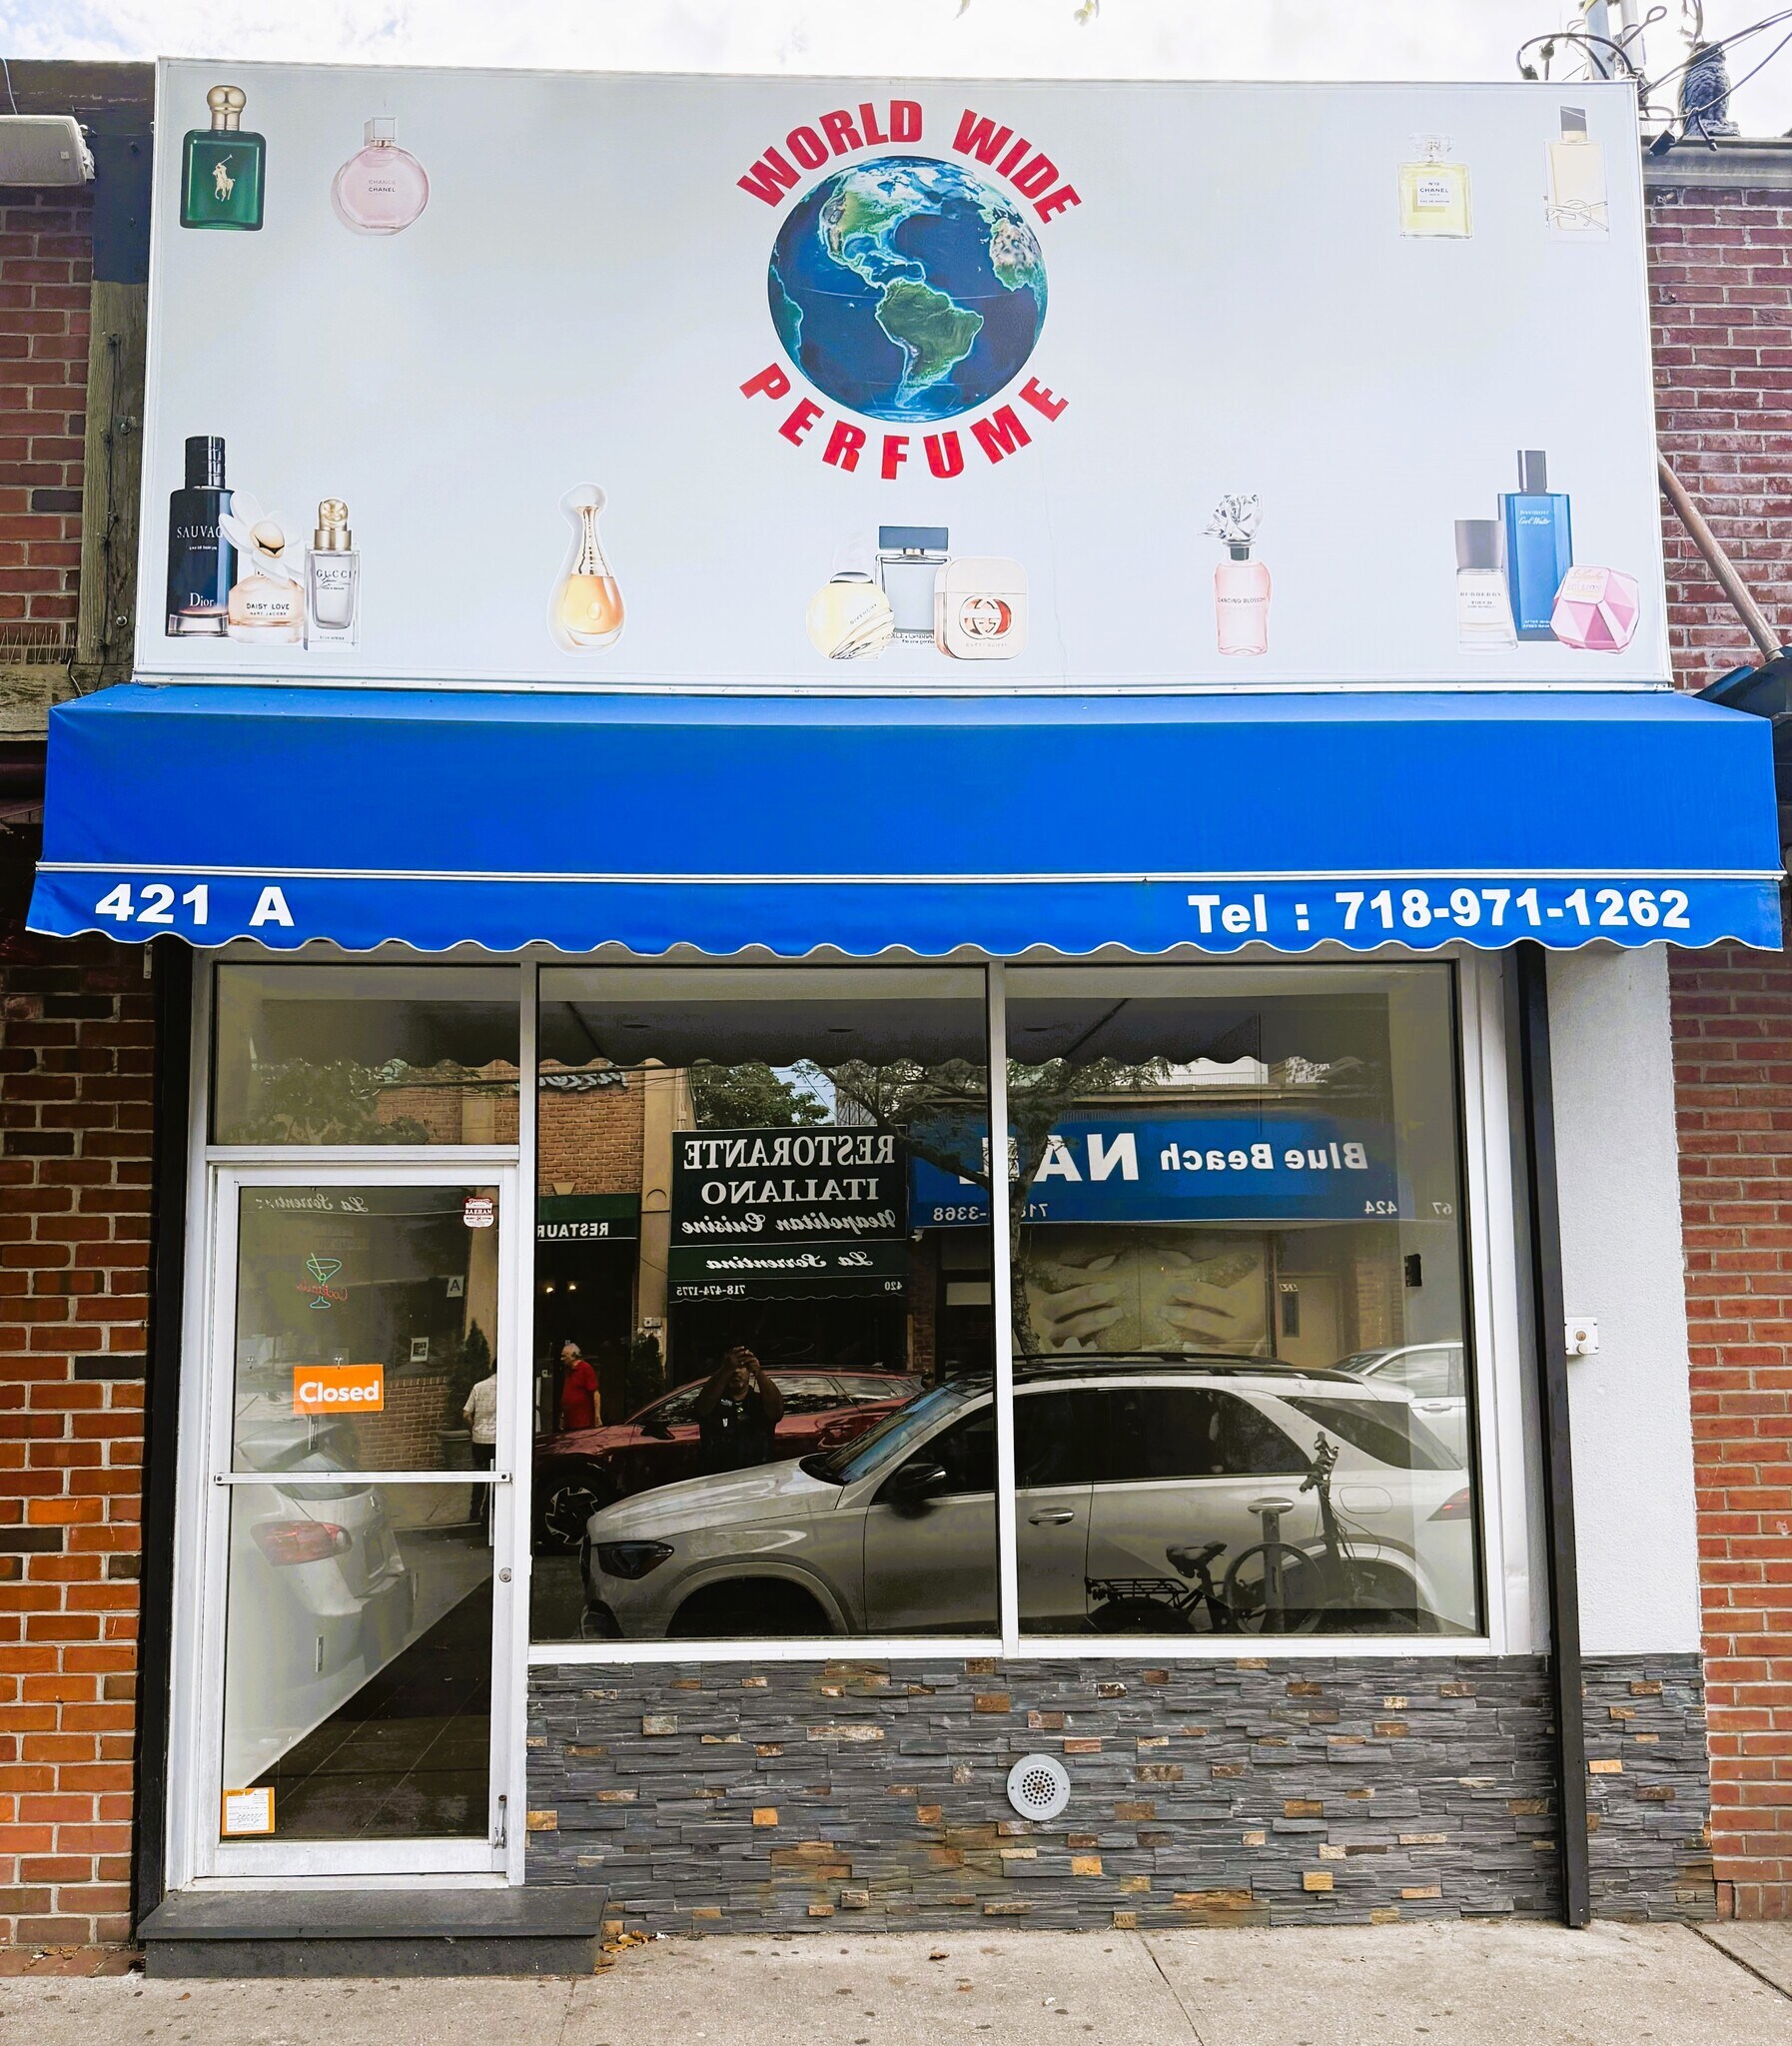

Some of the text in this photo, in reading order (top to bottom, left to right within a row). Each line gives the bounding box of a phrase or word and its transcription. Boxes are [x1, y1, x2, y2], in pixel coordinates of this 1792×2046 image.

[736, 100, 1082, 224] WORLD WIDE
[739, 362, 1069, 480] PERFUME
[189, 592, 214, 607] Dior
[95, 883, 295, 927] 421 A
[1188, 894, 1268, 933] Tel
[1336, 888, 1690, 930] 718-971-1262
[299, 1380, 380, 1404] Closed
